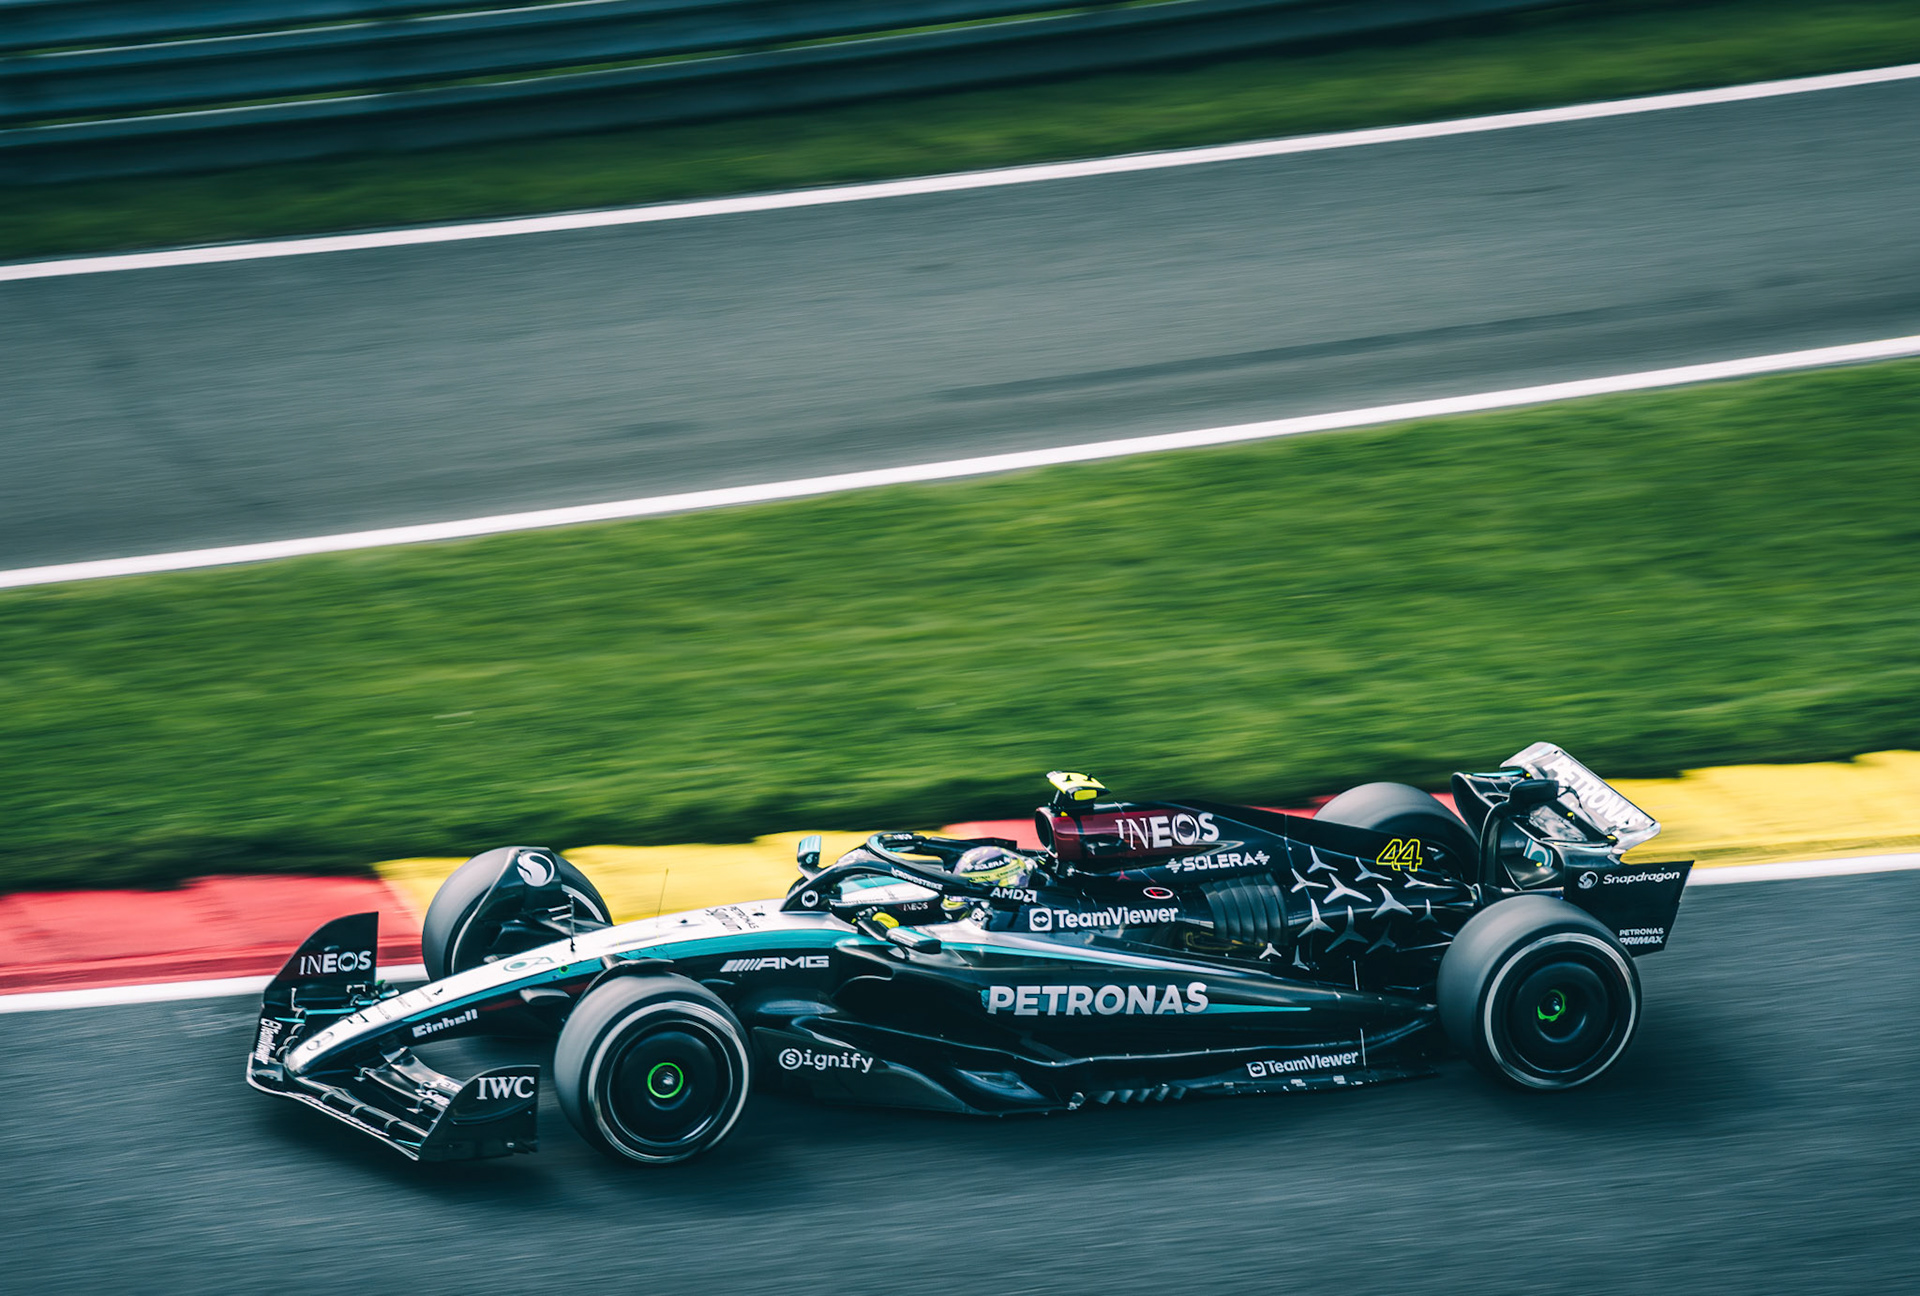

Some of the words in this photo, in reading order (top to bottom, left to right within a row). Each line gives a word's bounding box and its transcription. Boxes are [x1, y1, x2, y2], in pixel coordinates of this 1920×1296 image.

[1543, 754, 1646, 829] PETRONAS
[1115, 812, 1220, 850] INEOS
[973, 860, 1004, 870] SOLERA
[1183, 852, 1258, 872] SOLERA
[1376, 838, 1423, 872] 44
[894, 869, 944, 891] CROWDSTRIKE
[1603, 871, 1680, 884] Snapdragon
[990, 887, 1024, 901] AMD
[903, 902, 929, 911] INEOS
[1054, 907, 1179, 929] TeamViewer
[1619, 927, 1664, 936] PETRONAS
[1619, 935, 1665, 946] PRIMAX
[299, 949, 372, 976] INEOS
[760, 956, 830, 971] AMG
[987, 982, 1209, 1016] PETRONAS
[412, 1009, 478, 1038] Einhell
[1264, 1051, 1359, 1074] TeamViewer
[476, 1076, 535, 1100] IWC
